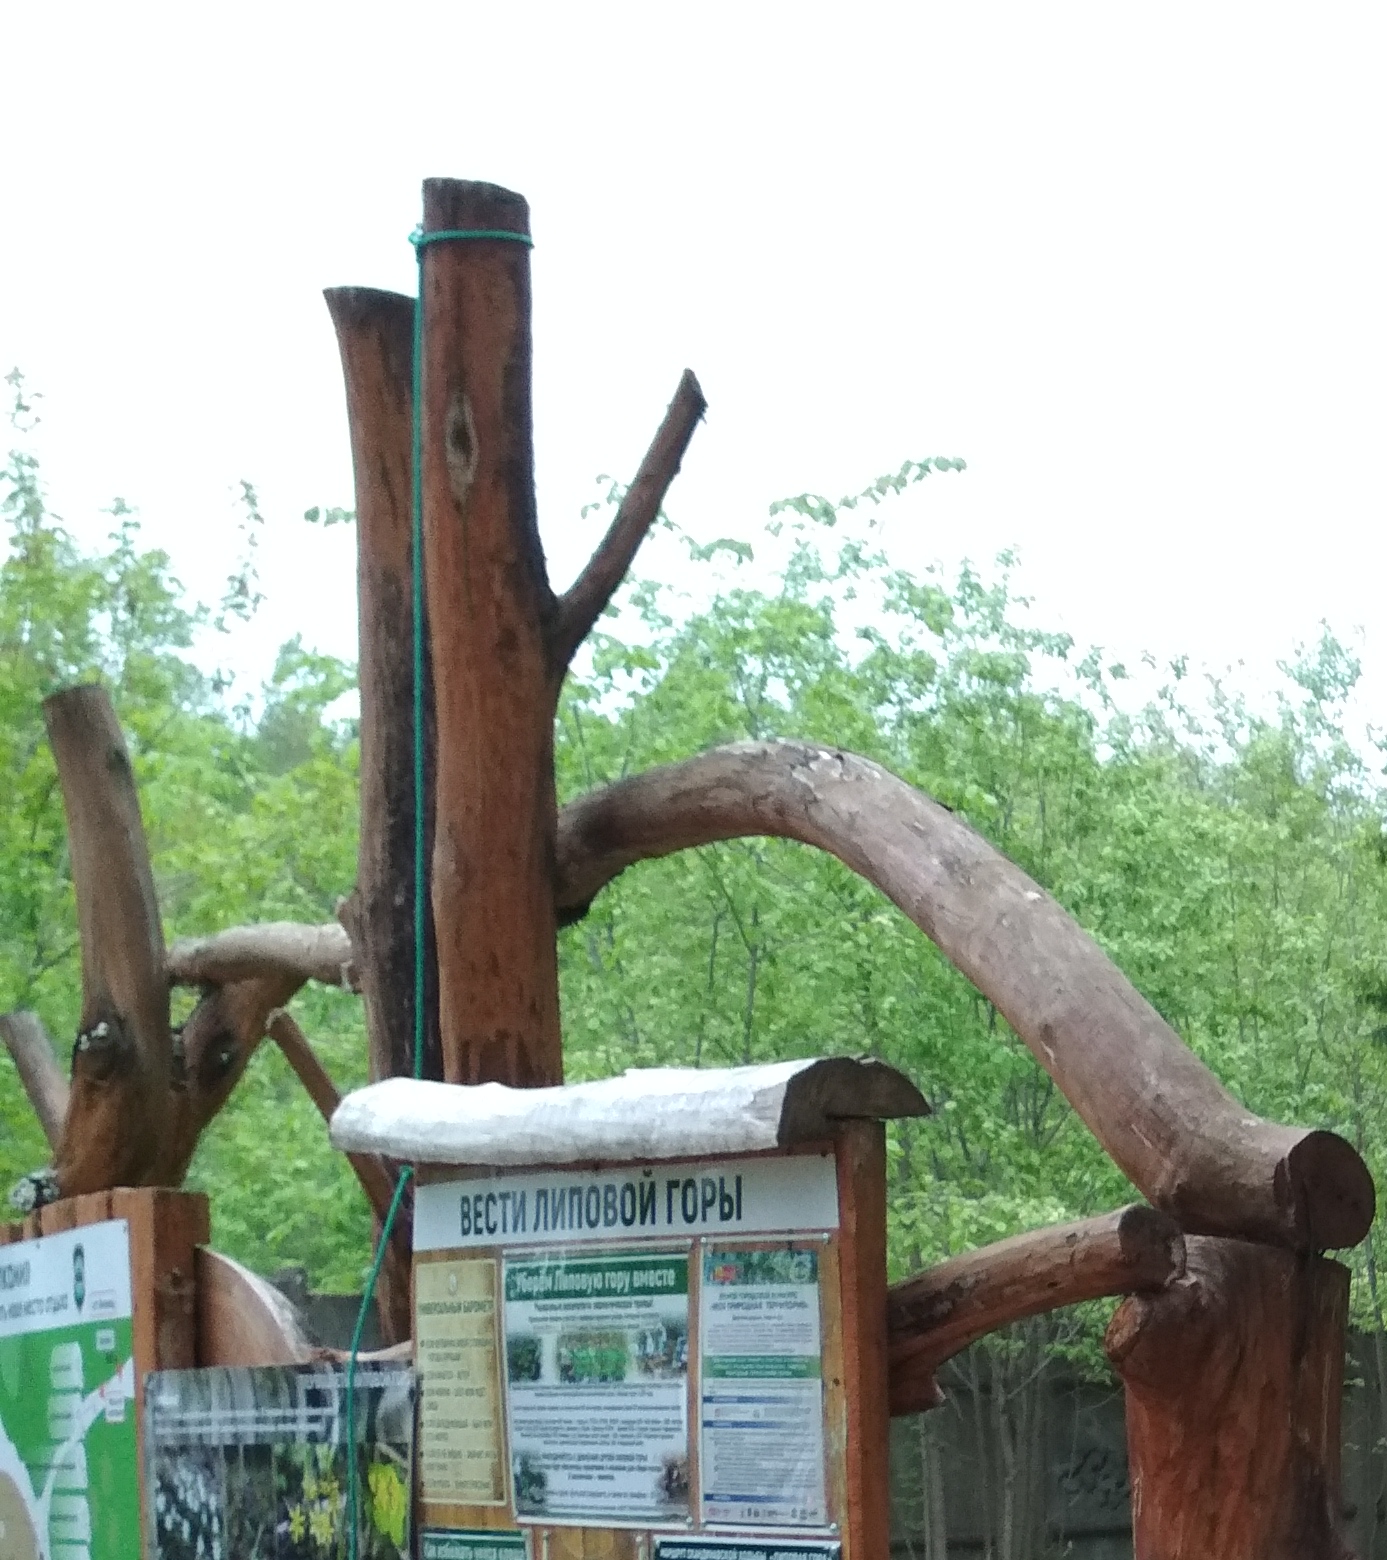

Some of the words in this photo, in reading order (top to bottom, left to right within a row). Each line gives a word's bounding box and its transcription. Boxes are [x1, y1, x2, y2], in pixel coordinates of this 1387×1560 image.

[460, 1191, 527, 1236] ВЕСТИ
[532, 1170, 657, 1232] ЛИПОВОЙ
[666, 1174, 743, 1225] ГОРЫ
